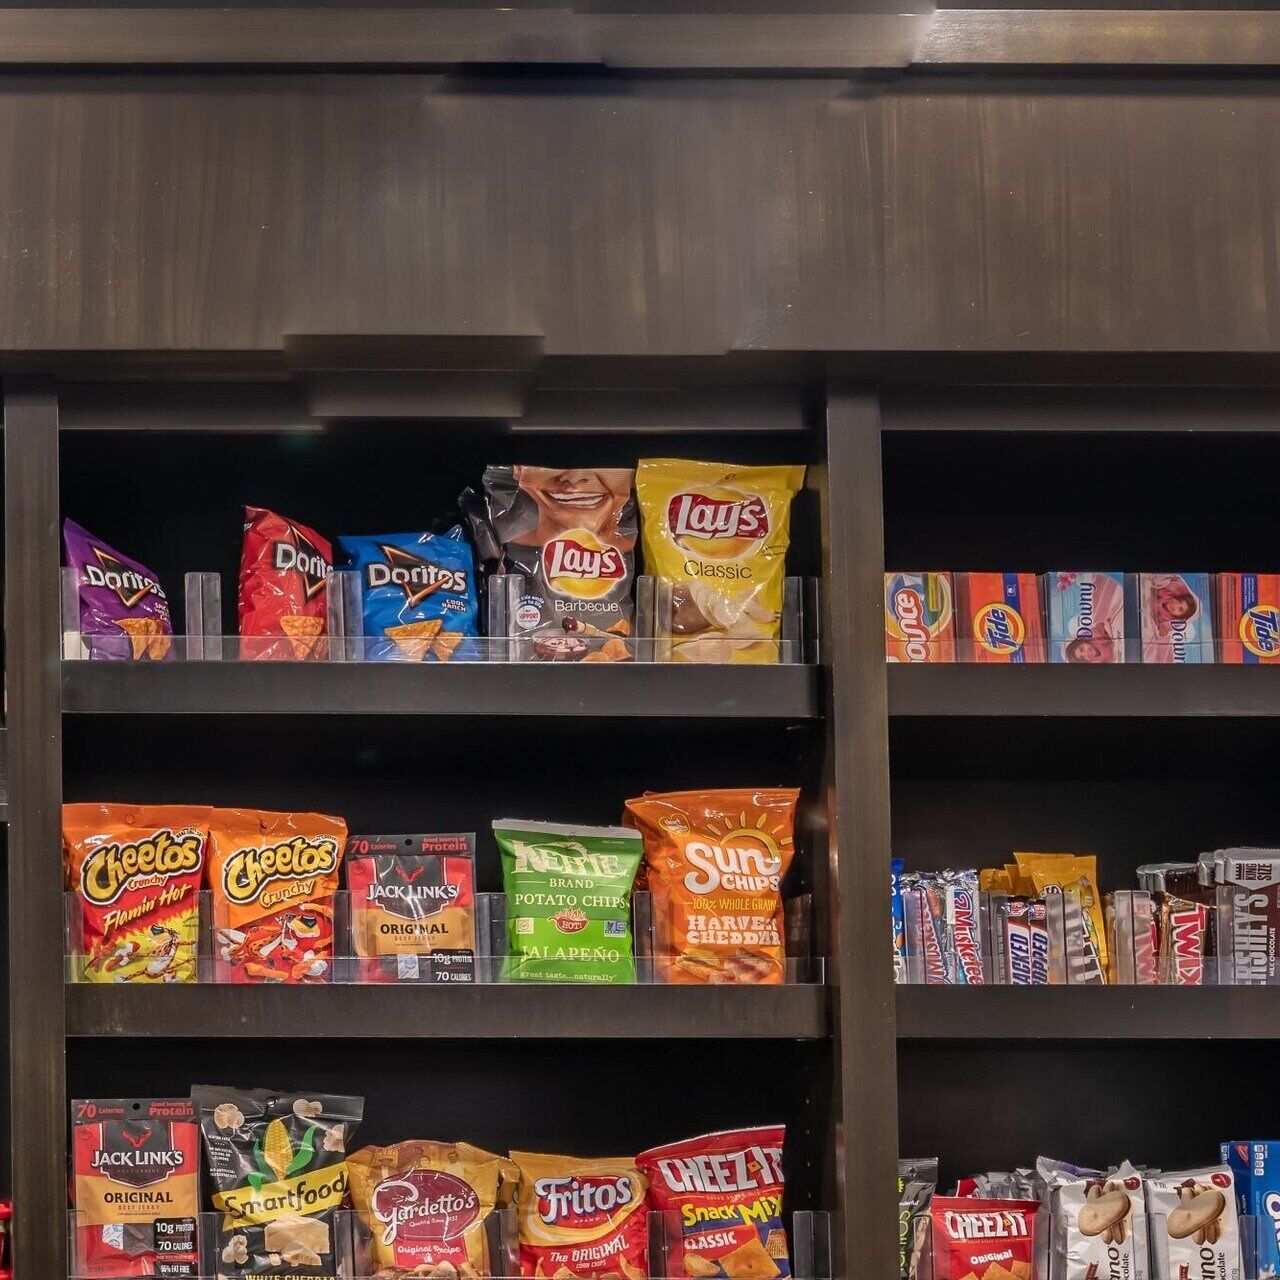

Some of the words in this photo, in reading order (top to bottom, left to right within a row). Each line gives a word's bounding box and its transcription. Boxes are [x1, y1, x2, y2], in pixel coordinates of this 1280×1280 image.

[676, 494, 762, 541] Lay's
[549, 541, 618, 579] Lay's
[368, 562, 467, 592] Doritos
[683, 559, 753, 580] Classic
[85, 564, 167, 600] Doritos
[554, 599, 619, 613] Barbecue
[1076, 581, 1097, 640] Downy
[985, 606, 1020, 651] Tide
[1248, 607, 1280, 653] Tide
[350, 839, 370, 854] 70
[422, 842, 468, 852] Protein
[82, 831, 201, 905] Cheetos
[222, 836, 339, 904] Cheetos
[684, 840, 782, 895] Sun
[1245, 863, 1257, 881] KING
[1257, 863, 1272, 881] SIZE
[127, 874, 169, 891] Crunchy
[549, 878, 594, 889] BRAND
[720, 874, 781, 893] CHIPS
[259, 879, 316, 908] Crunchy
[366, 884, 408, 901] JACK
[407, 884, 458, 900] LINK'S
[515, 893, 577, 906] POTATO
[582, 895, 626, 909] CHIPS
[102, 896, 156, 936] Flamin'
[158, 884, 193, 905] Hot
[692, 898, 717, 910] 100%
[719, 898, 750, 910] WHOLE
[751, 899, 778, 911] GRAIN
[379, 923, 450, 935] ORIGINAL
[561, 920, 583, 929] HOT!
[433, 953, 452, 965] 10g
[520, 945, 620, 963] JALAPEÑO
[435, 972, 450, 982] 70
[450, 972, 472, 982] CALORIES
[77, 1102, 97, 1119] 70
[149, 1106, 195, 1116] Protein
[91, 1150, 135, 1168] JACK
[135, 1149, 184, 1167] LINK'S
[103, 1191, 174, 1203] ORIGINAL
[224, 1170, 346, 1220] Smartfood
[534, 1176, 632, 1225] Fritos
[371, 1179, 476, 1246] Gardetto's
[681, 1203, 730, 1227] Snack
[727, 1194, 783, 1226] Mix
[155, 1222, 174, 1234] 10g
[175, 1222, 195, 1233] PROTEIN
[158, 1241, 172, 1251] 70
[172, 1241, 194, 1251] CALORIES
[550, 1251, 569, 1263] The
[571, 1233, 630, 1262] ORIGINAL
[683, 1230, 727, 1250] CLASSIC
[397, 1245, 432, 1255] Original
[434, 1245, 461, 1255] Recipe
